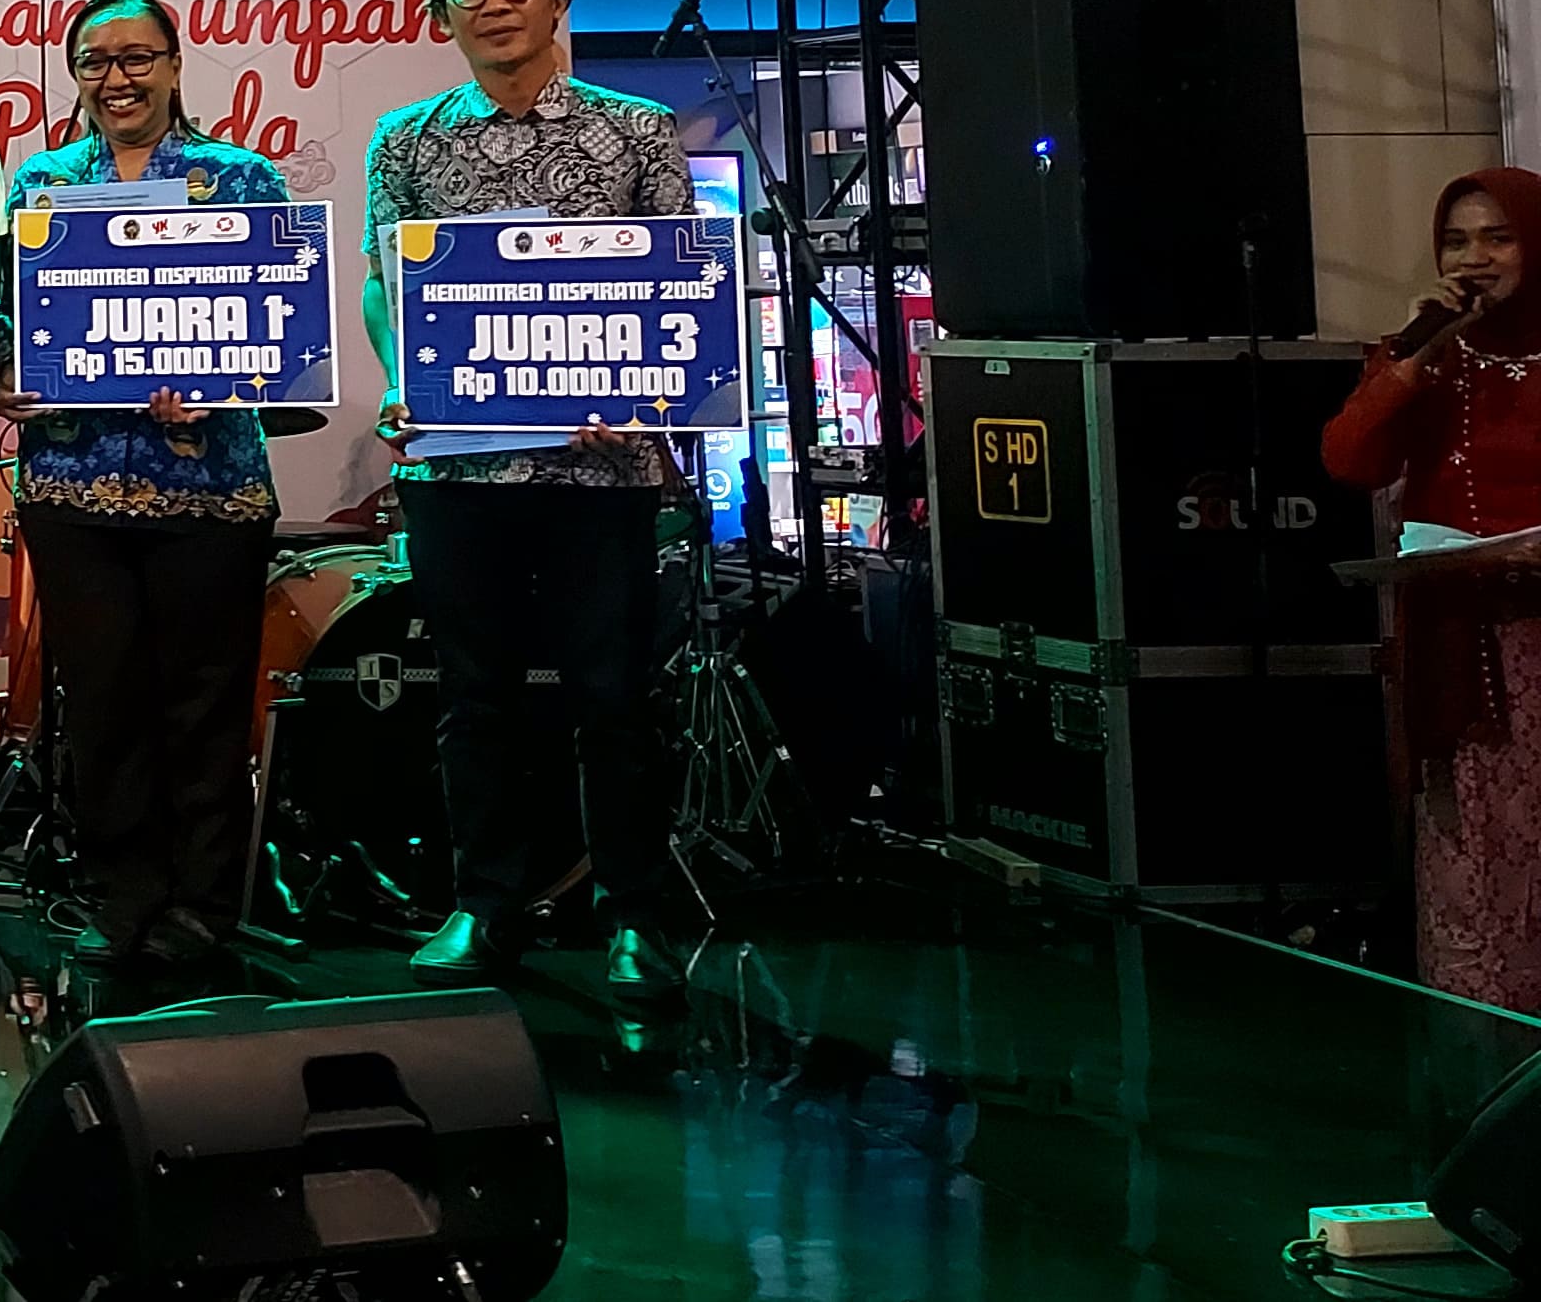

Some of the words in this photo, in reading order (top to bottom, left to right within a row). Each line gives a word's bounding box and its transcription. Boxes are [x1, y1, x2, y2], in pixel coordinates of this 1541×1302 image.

[37, 266, 150, 288] KEMANTREN
[153, 265, 253, 286] INSPIRATIF
[256, 263, 310, 283] 2005
[421, 282, 543, 303] KEMANTREN
[547, 281, 655, 302] INSPIRATIF
[659, 280, 716, 300] 2005
[85, 295, 248, 343] JUARA
[263, 294, 284, 341] 1
[467, 313, 643, 362] JUARA
[659, 312, 698, 362] 3
[65, 347, 106, 382] Rp
[112, 345, 282, 376] 15.000.000
[453, 366, 496, 402] Rp
[503, 365, 687, 397] 10.000.000
[984, 431, 999, 464] S
[1007, 431, 1038, 464] HD
[1008, 472, 1020, 510] 1
